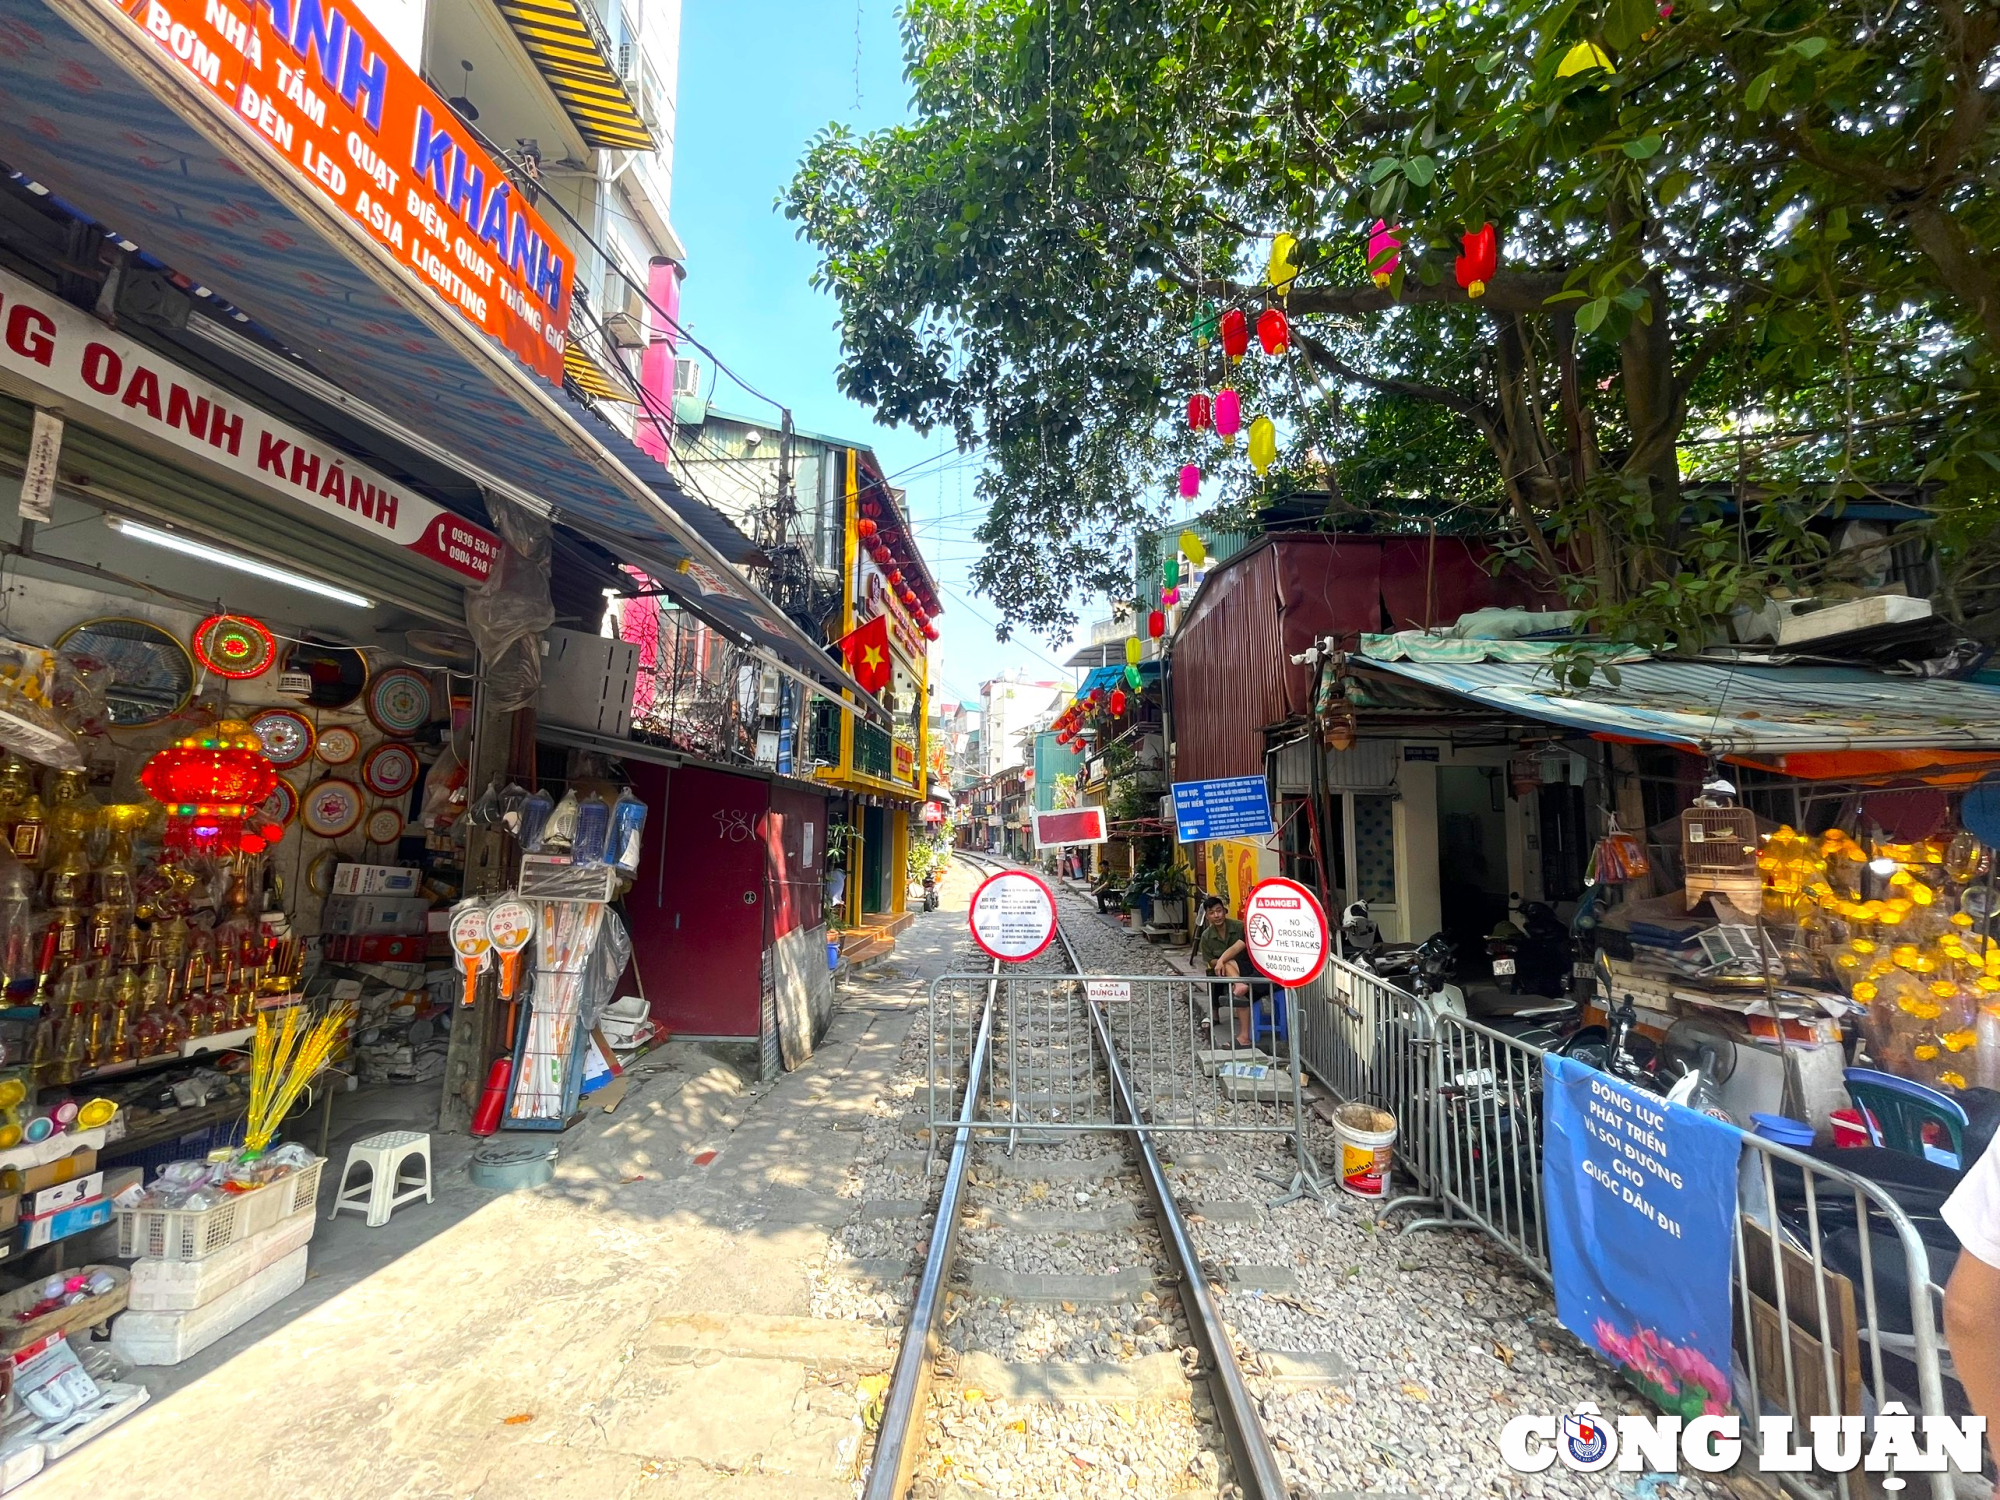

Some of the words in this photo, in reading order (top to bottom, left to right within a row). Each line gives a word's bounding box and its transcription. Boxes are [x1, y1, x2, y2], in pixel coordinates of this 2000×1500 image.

[146, 0, 221, 87] BƠM
[240, 83, 294, 152] ĐÈN
[302, 139, 347, 196] LED
[355, 190, 403, 251] ASIA
[411, 237, 487, 323] LIGHTING
[205, 0, 262, 71] NHÀ
[276, 58, 327, 129] TẮM
[347, 131, 399, 196] QUẠT
[407, 188, 450, 253] ĐIỆN,
[499, 276, 542, 334] THÔNG
[545, 323, 565, 354] GIÓ
[411, 105, 563, 311] KHÁNH
[81, 342, 244, 457] OANH
[257, 430, 399, 530] KHÁNH
[451, 526, 474, 548] 0936
[474, 538, 490, 556] 534
[449, 544, 471, 566] 0904
[471, 556, 488, 573] 248
[1177, 790, 1188, 798] KHU
[1264, 899, 1298, 908] DANGER
[1278, 930, 1314, 938] CROSSING
[1289, 919, 1301, 927] NO
[1267, 954, 1283, 962] MAX
[1284, 956, 1300, 964] FINE
[1275, 940, 1290, 948] THE
[1291, 940, 1321, 950] TRACKS
[1265, 962, 1292, 972] 500.000
[1293, 965, 1306, 973] vnd
[1591, 1080, 1632, 1113] ĐỘNG
[1636, 1103, 1665, 1131] LỰC
[1589, 1099, 1622, 1131] PHÁT
[1626, 1120, 1668, 1158] TRIỂN
[1583, 1114, 1597, 1137] VÀ
[1599, 1129, 1622, 1152] SOI
[1624, 1144, 1684, 1190] ĐƯỜNG
[1612, 1158, 1645, 1188] CHO
[1582, 1159, 1620, 1196] QUỐC
[1622, 1186, 1655, 1221] DÂN
[1657, 1211, 1682, 1240] ĐI!
